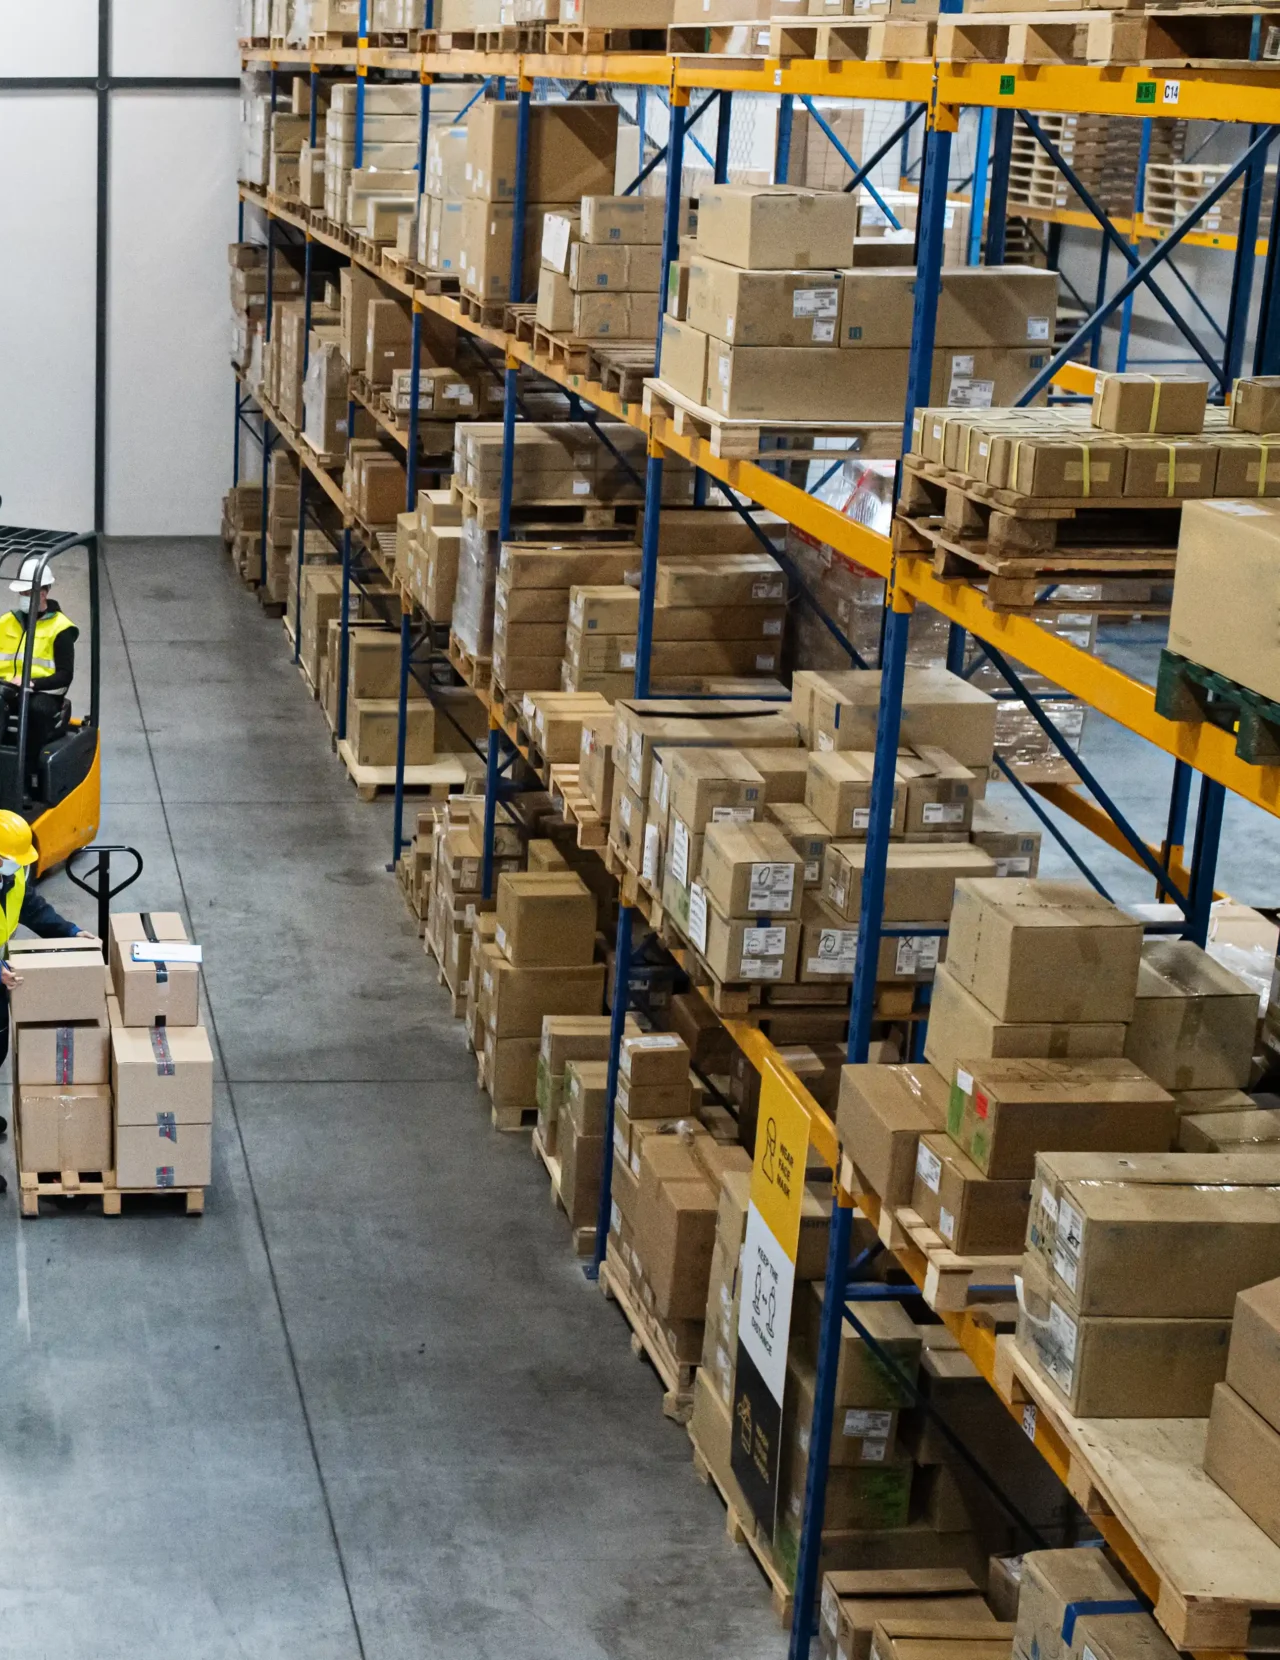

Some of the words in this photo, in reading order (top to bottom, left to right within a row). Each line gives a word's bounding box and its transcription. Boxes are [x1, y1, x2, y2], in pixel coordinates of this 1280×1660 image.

[1165, 85, 1178, 98] C14
[780, 1143, 794, 1168] WEAR
[779, 1158, 790, 1182] FACE
[777, 1174, 790, 1199] MASK
[758, 1245, 769, 1267] KEEP
[770, 1263, 778, 1284] THE
[752, 1316, 772, 1357] DISTANCE
